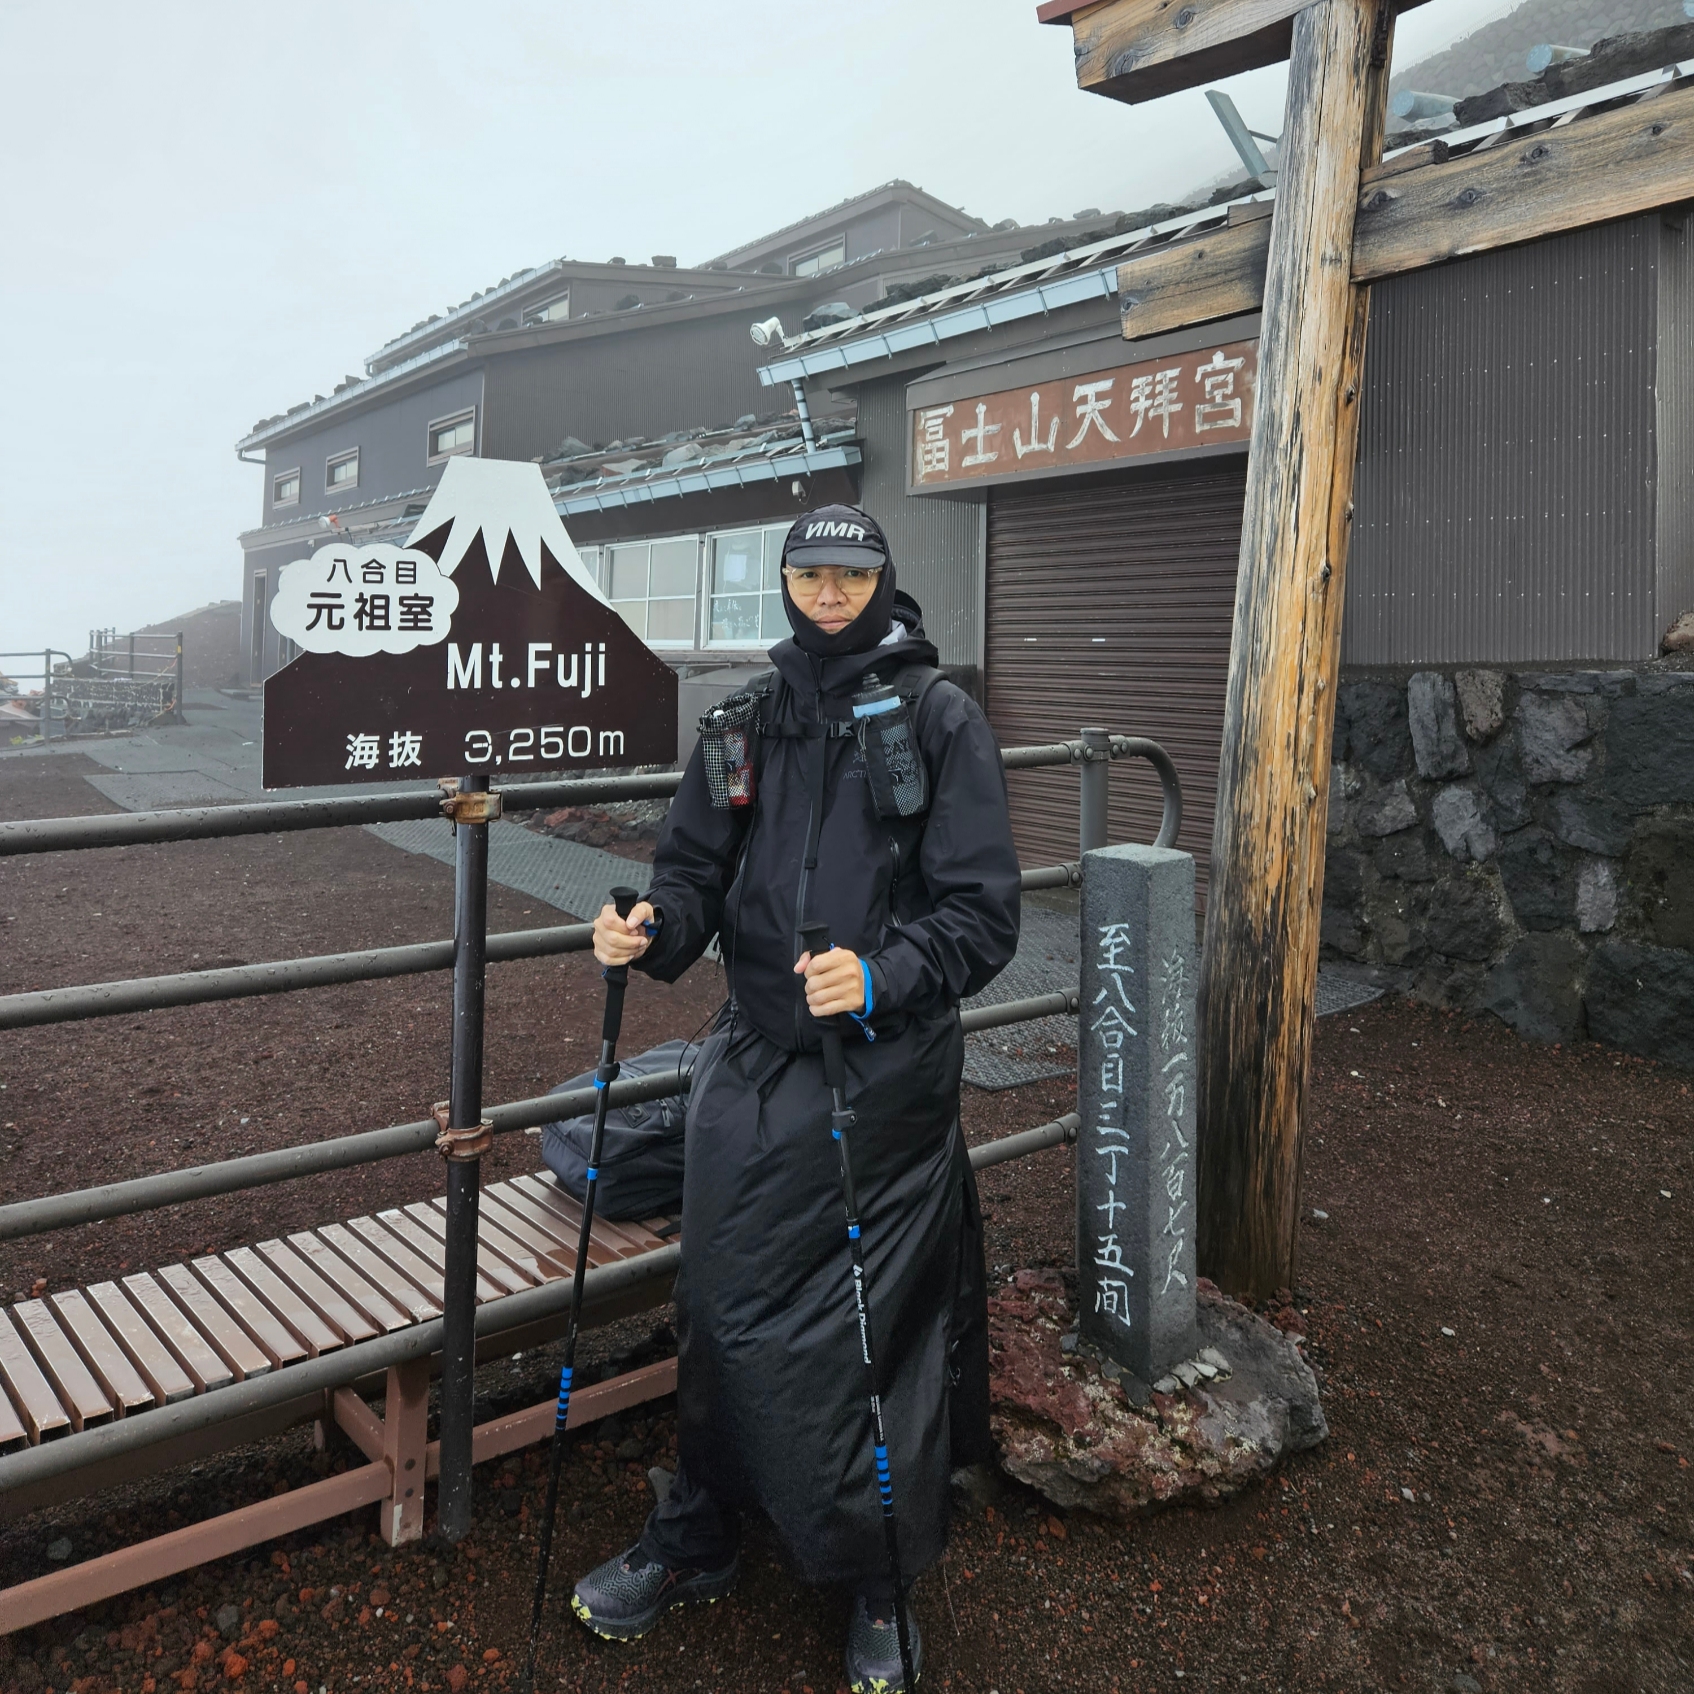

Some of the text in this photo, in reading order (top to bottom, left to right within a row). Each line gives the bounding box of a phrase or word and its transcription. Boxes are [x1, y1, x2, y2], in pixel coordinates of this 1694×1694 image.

[326, 558, 417, 584] 八合目
[305, 591, 434, 631] 元祖室
[446, 642, 607, 699] Mt.Fuji
[344, 730, 423, 770] 海抜
[859, 1313, 871, 1363] Diamond
